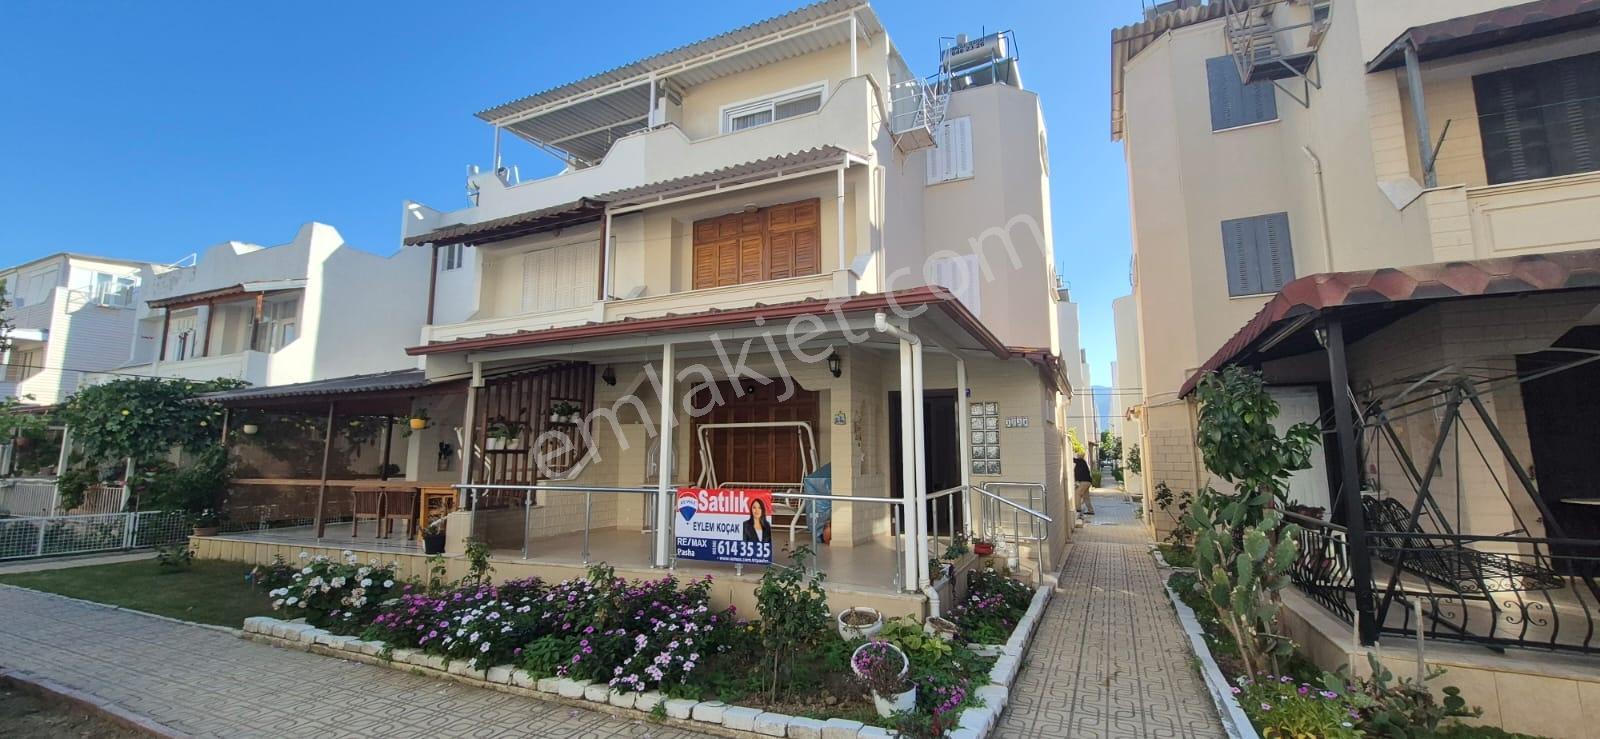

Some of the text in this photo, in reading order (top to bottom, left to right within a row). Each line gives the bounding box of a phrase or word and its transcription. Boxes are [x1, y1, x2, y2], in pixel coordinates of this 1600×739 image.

[698, 490, 750, 513] Satılık
[693, 521, 740, 535] EYLEM KOÇAK
[677, 537, 708, 548] RE/MAX
[717, 540, 738, 556] 614
[740, 541, 754, 557] 35
[756, 542, 771, 558] 35
[677, 548, 696, 557] Pasha
